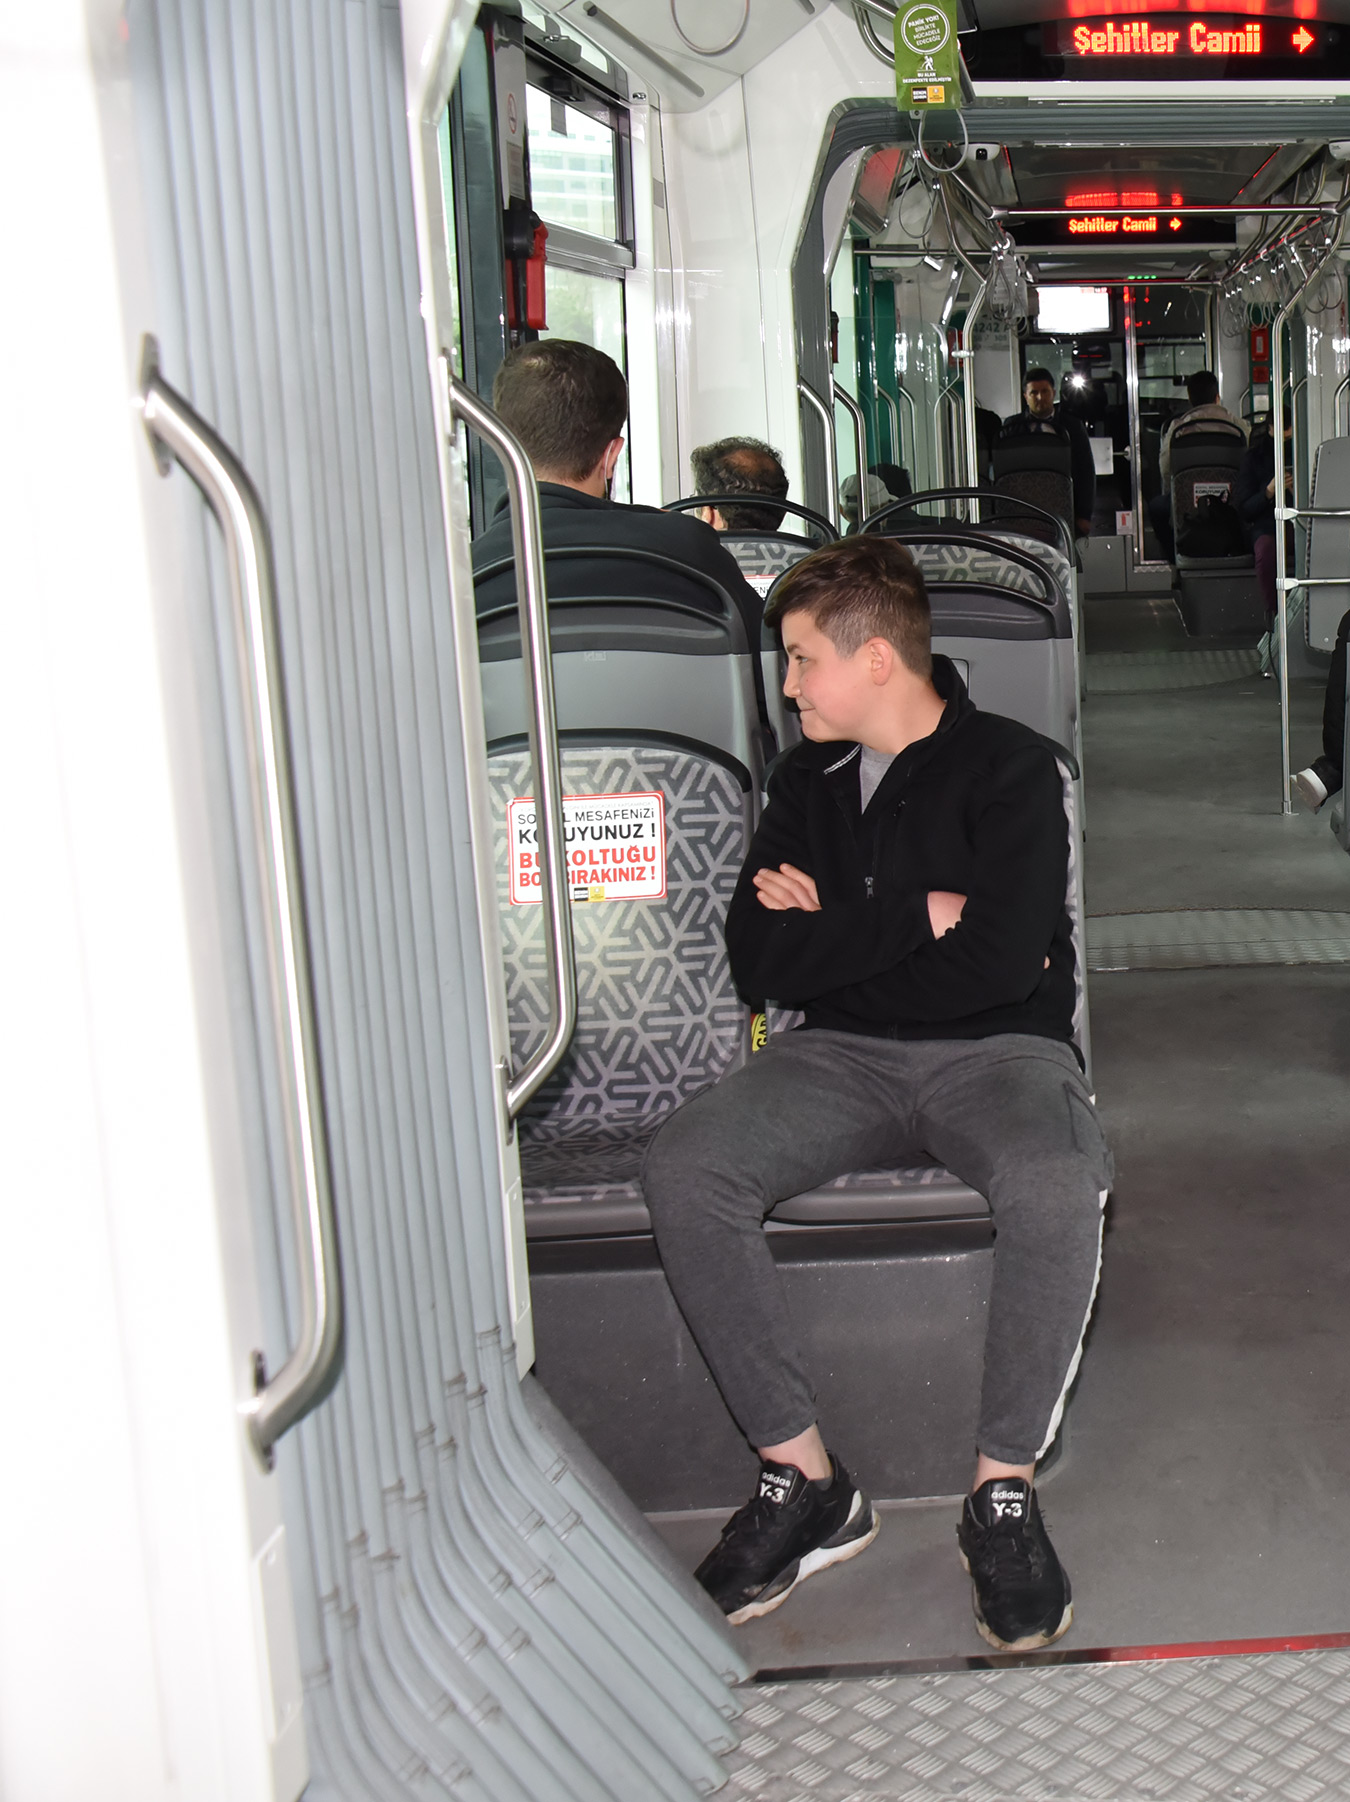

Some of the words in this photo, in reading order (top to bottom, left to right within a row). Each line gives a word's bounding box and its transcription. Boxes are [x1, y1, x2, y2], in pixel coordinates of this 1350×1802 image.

[913, 29, 941, 40] MÜCADELE
[1073, 21, 1180, 55] Şehitler
[1189, 21, 1261, 53] Camii
[1068, 216, 1119, 234] Şehitler
[1122, 216, 1157, 232] Camii
[518, 812, 571, 825] SOL
[519, 824, 644, 844] KUYUNUZ
[651, 823, 656, 837] !
[520, 872, 542, 887] BO
[651, 866, 656, 880] !
[762, 1472, 791, 1488] adidas
[760, 1482, 785, 1503] Y-3
[991, 1490, 1024, 1500] adidas
[992, 1502, 1022, 1518] Y-3
